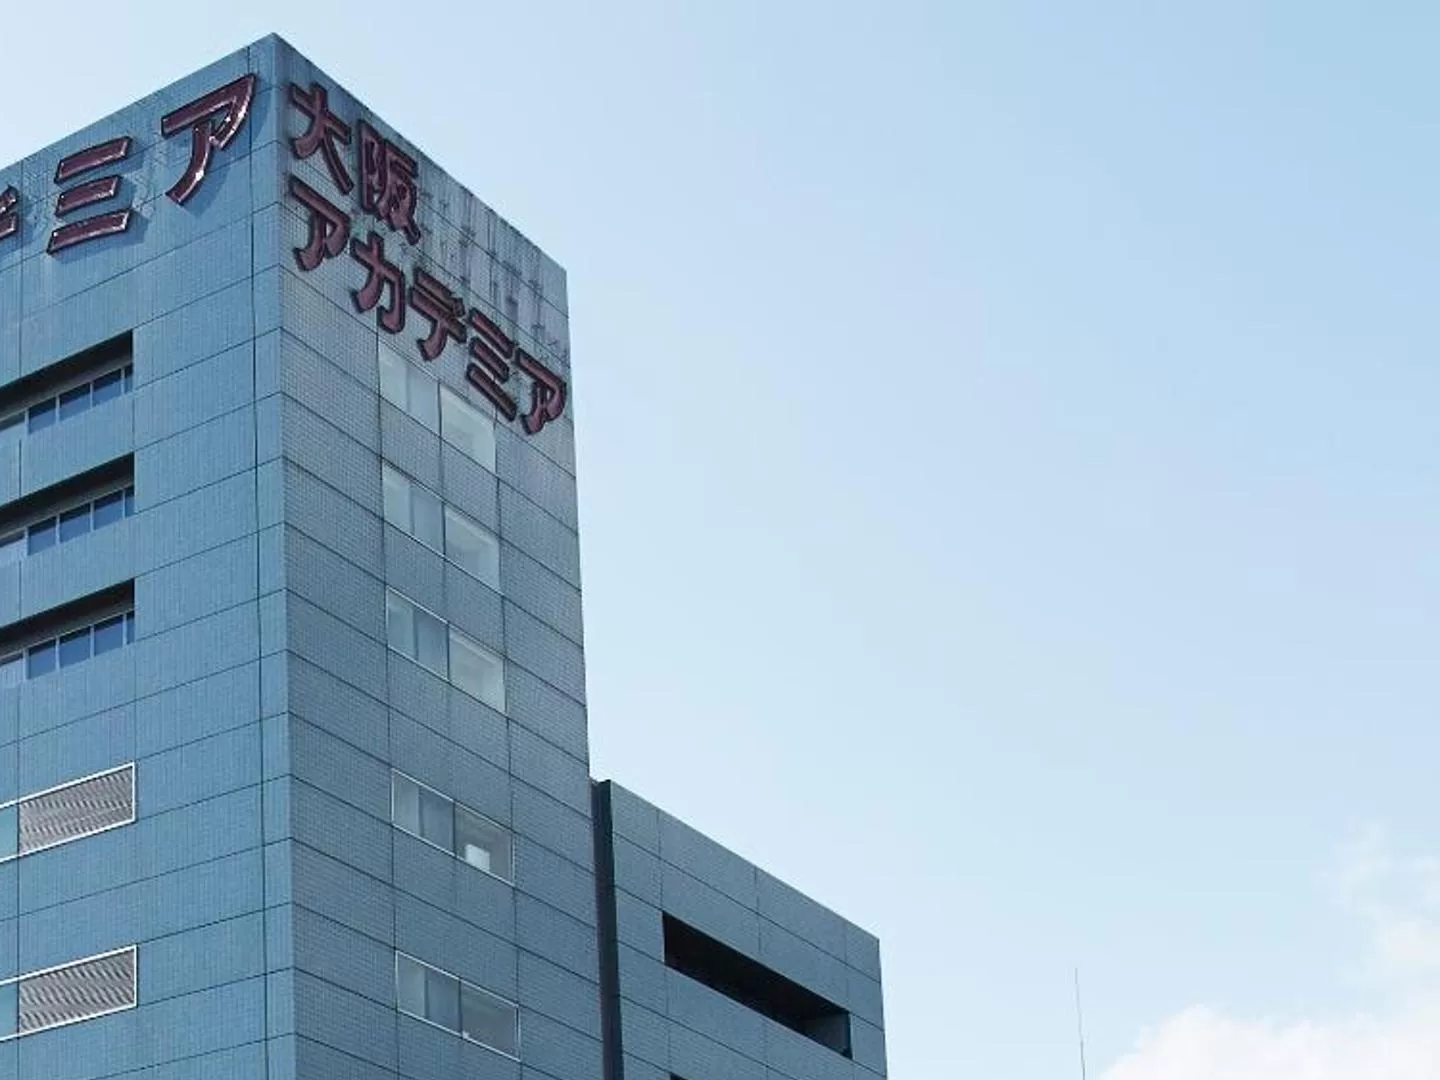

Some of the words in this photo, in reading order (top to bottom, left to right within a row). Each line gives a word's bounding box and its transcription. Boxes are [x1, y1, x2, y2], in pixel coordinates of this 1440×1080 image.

[287, 82, 421, 245] 大阪
[287, 174, 567, 435] アカデミア
